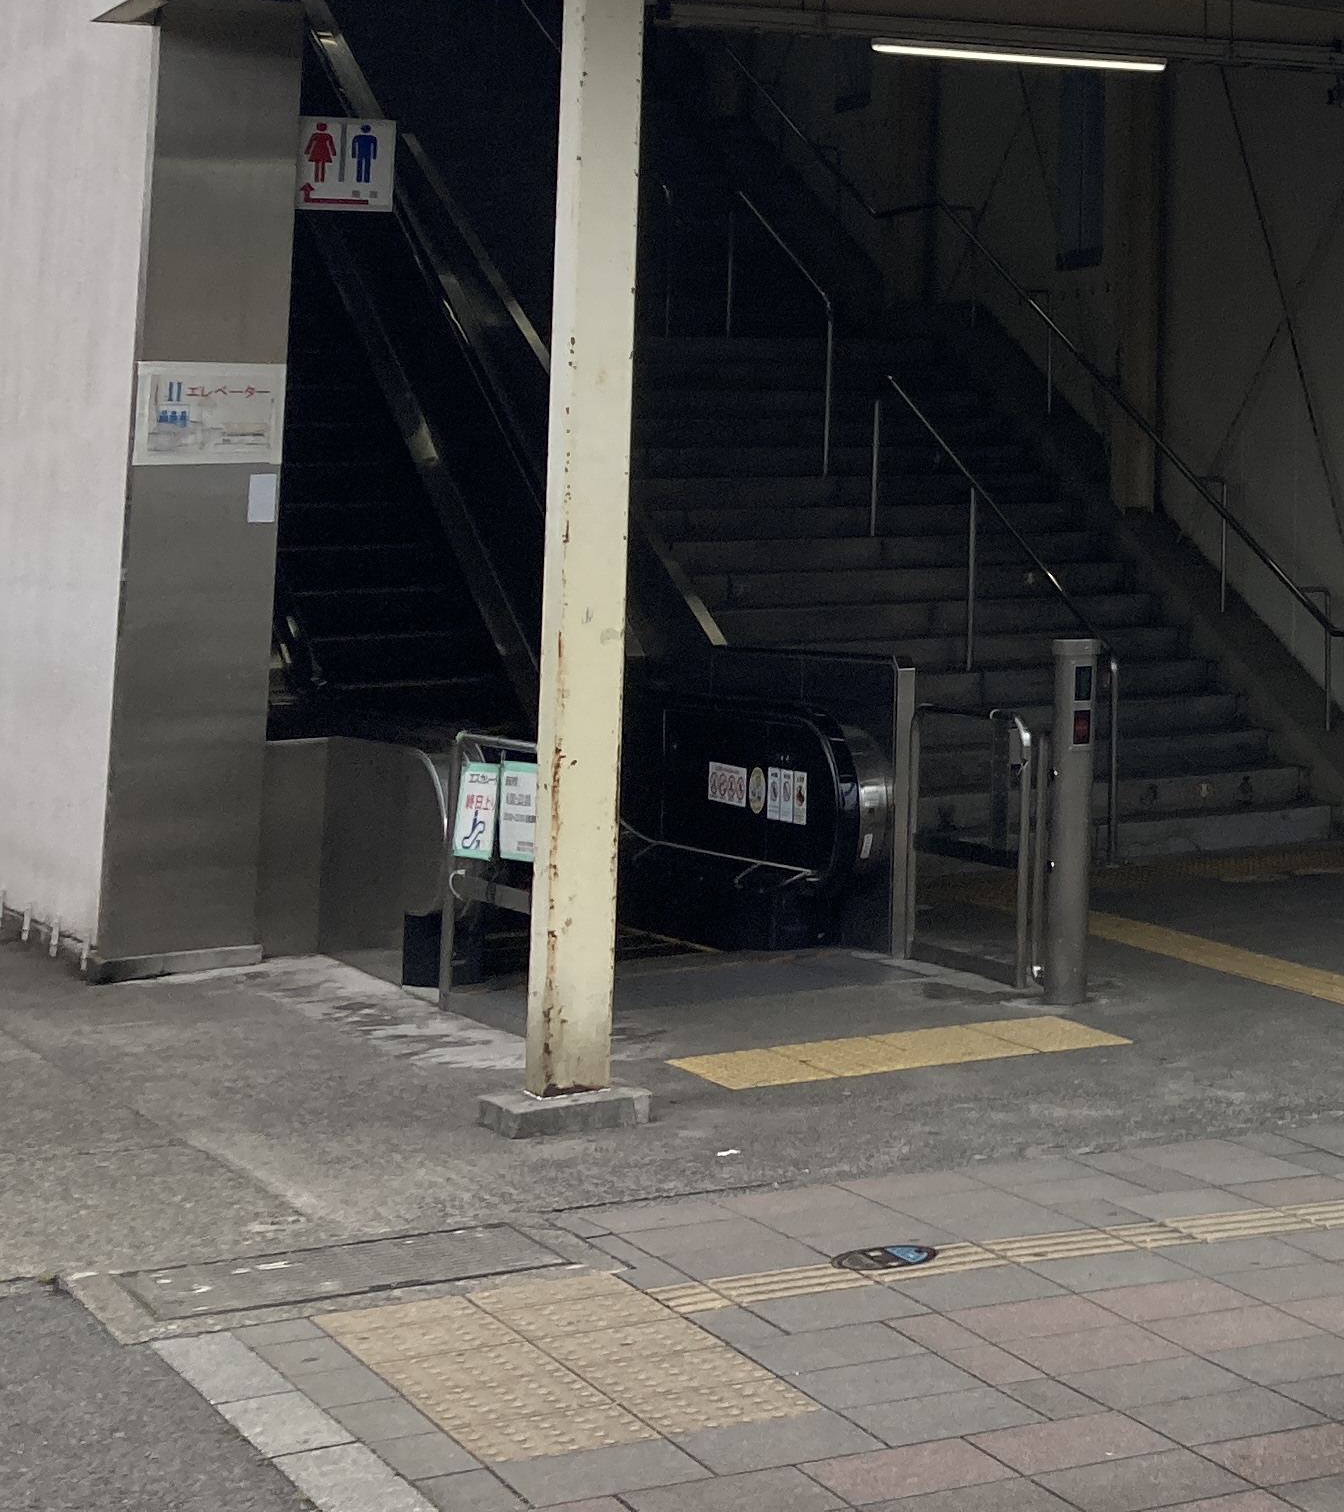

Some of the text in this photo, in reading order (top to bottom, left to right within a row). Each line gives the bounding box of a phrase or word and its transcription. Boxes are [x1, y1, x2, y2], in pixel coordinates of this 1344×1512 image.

[185, 385, 271, 399] エレベーター
